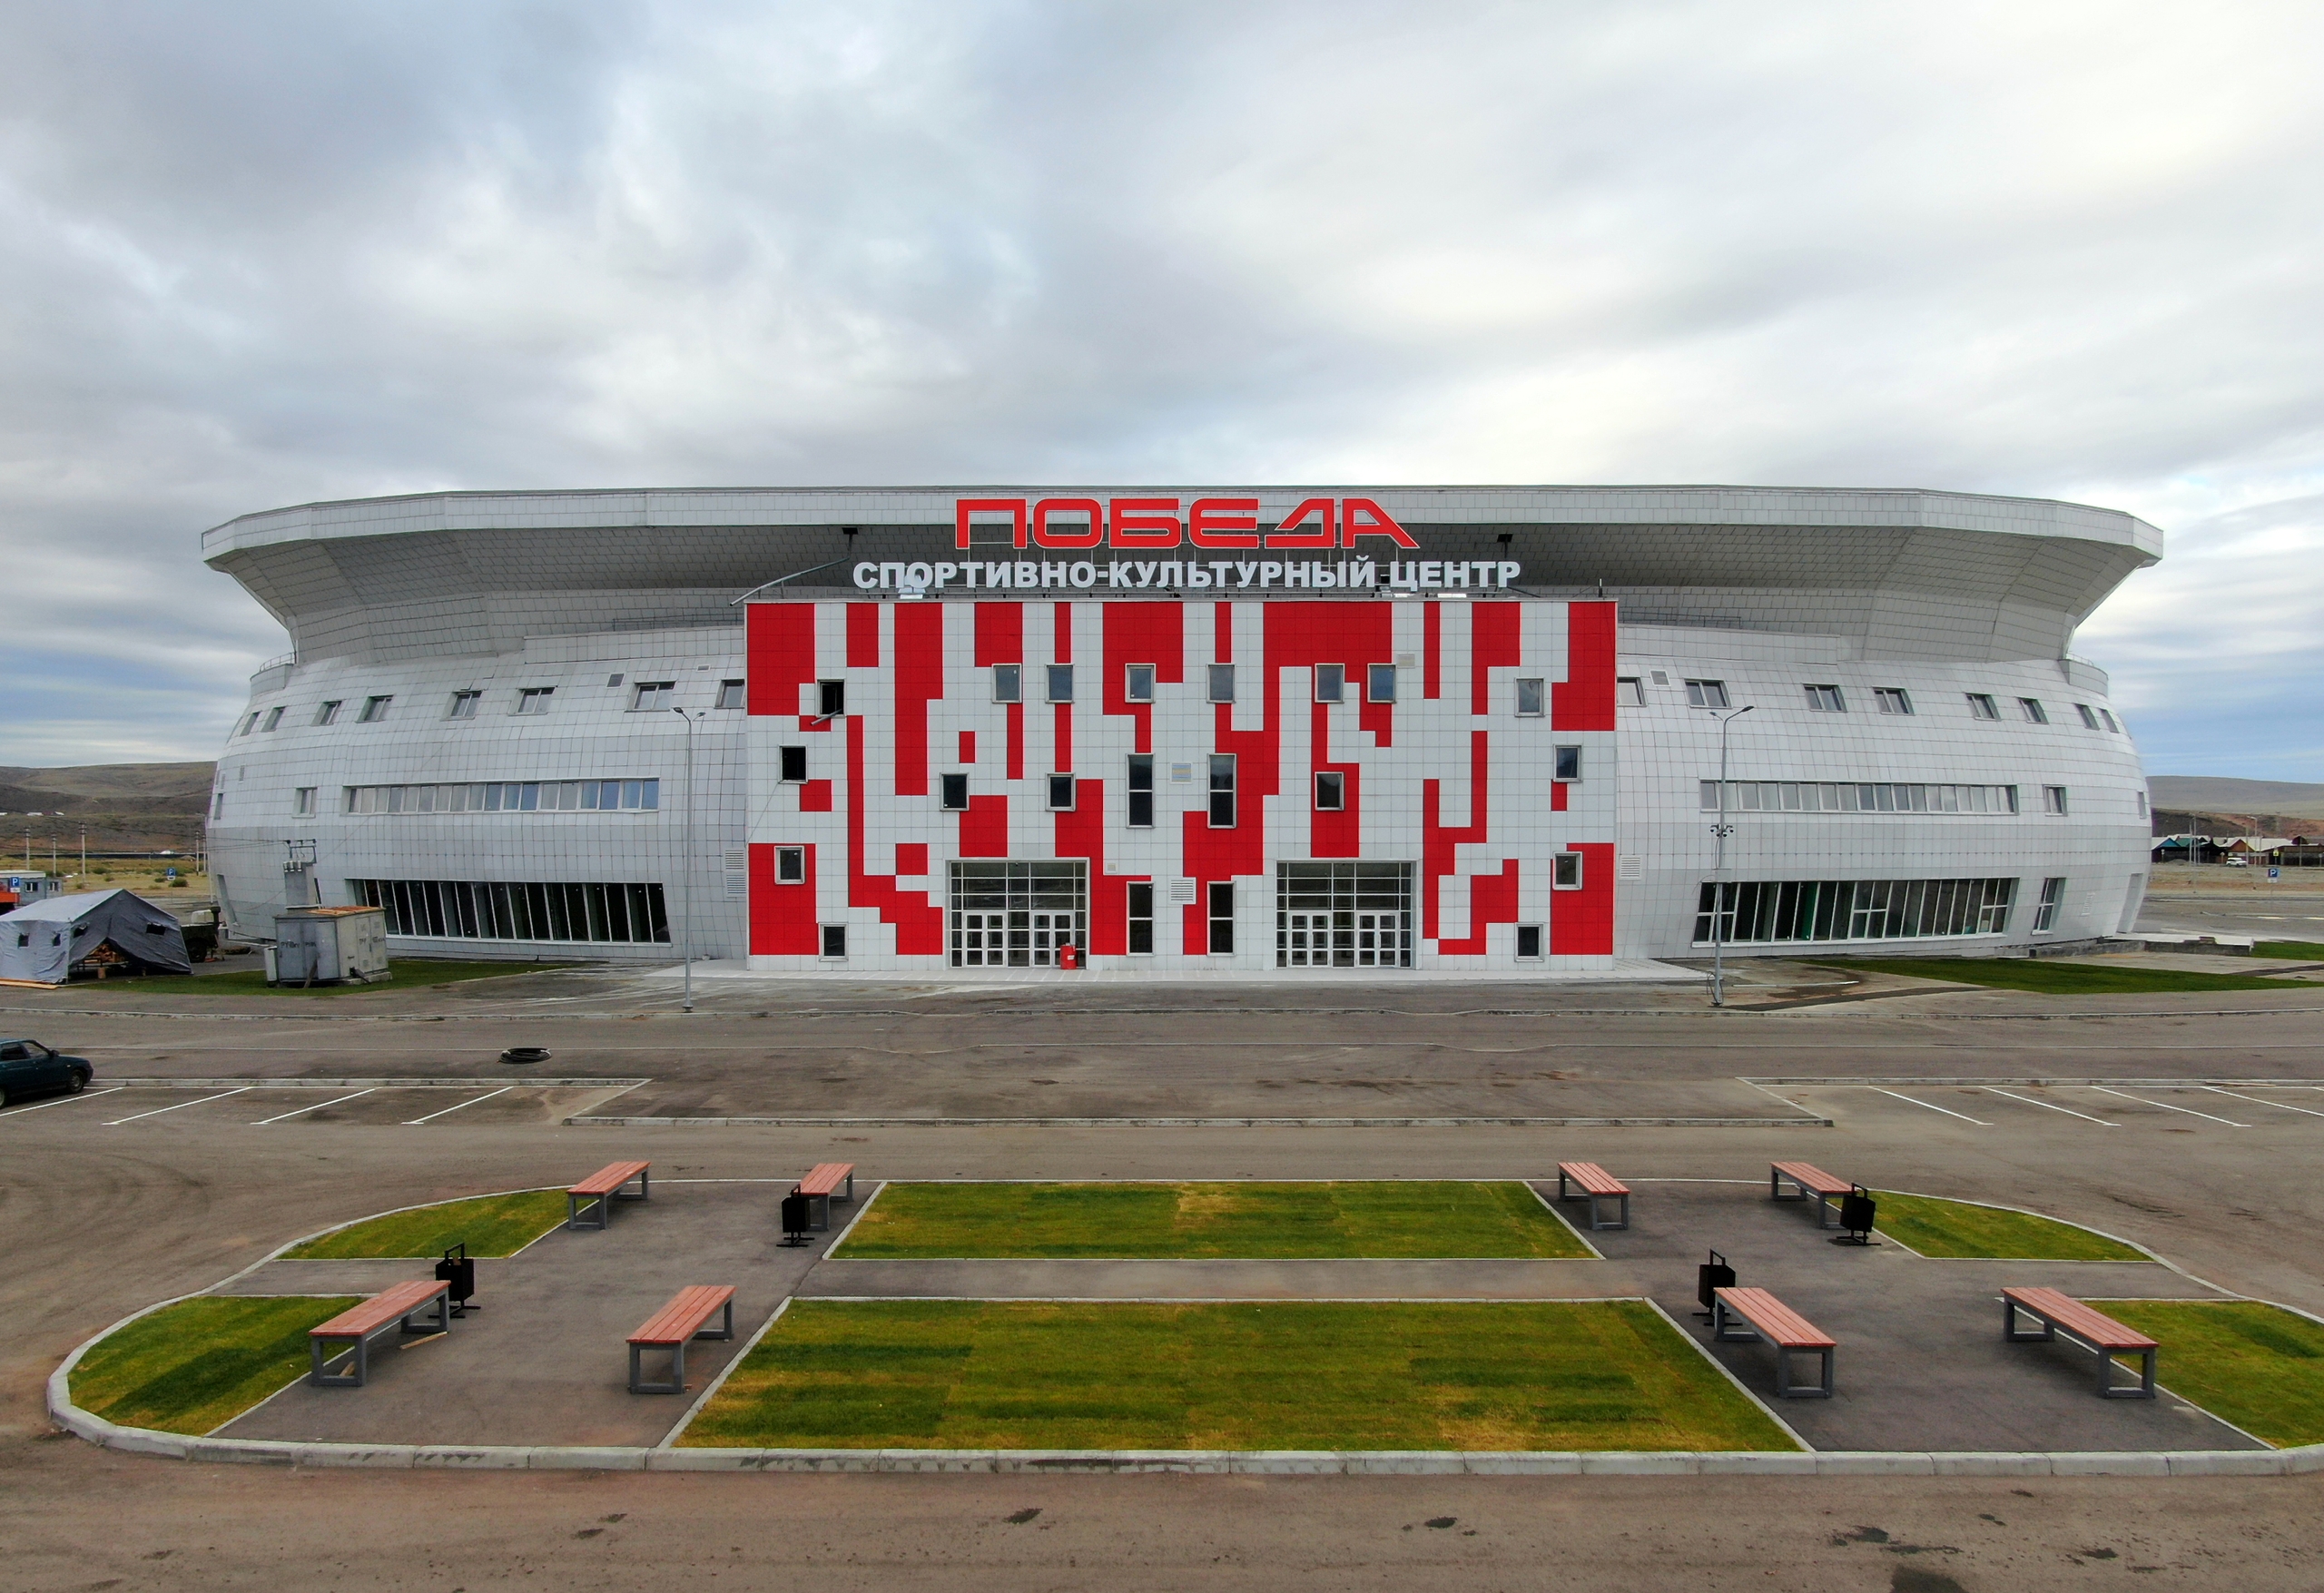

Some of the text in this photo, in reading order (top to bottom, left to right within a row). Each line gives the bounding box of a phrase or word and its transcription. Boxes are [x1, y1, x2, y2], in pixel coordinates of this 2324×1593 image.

[955, 498, 1420, 549] ПОБЕДА
[853, 555, 1521, 592] СПОРТИВНО-КУЛЬТУРНЫЙ ЦЕНТР
